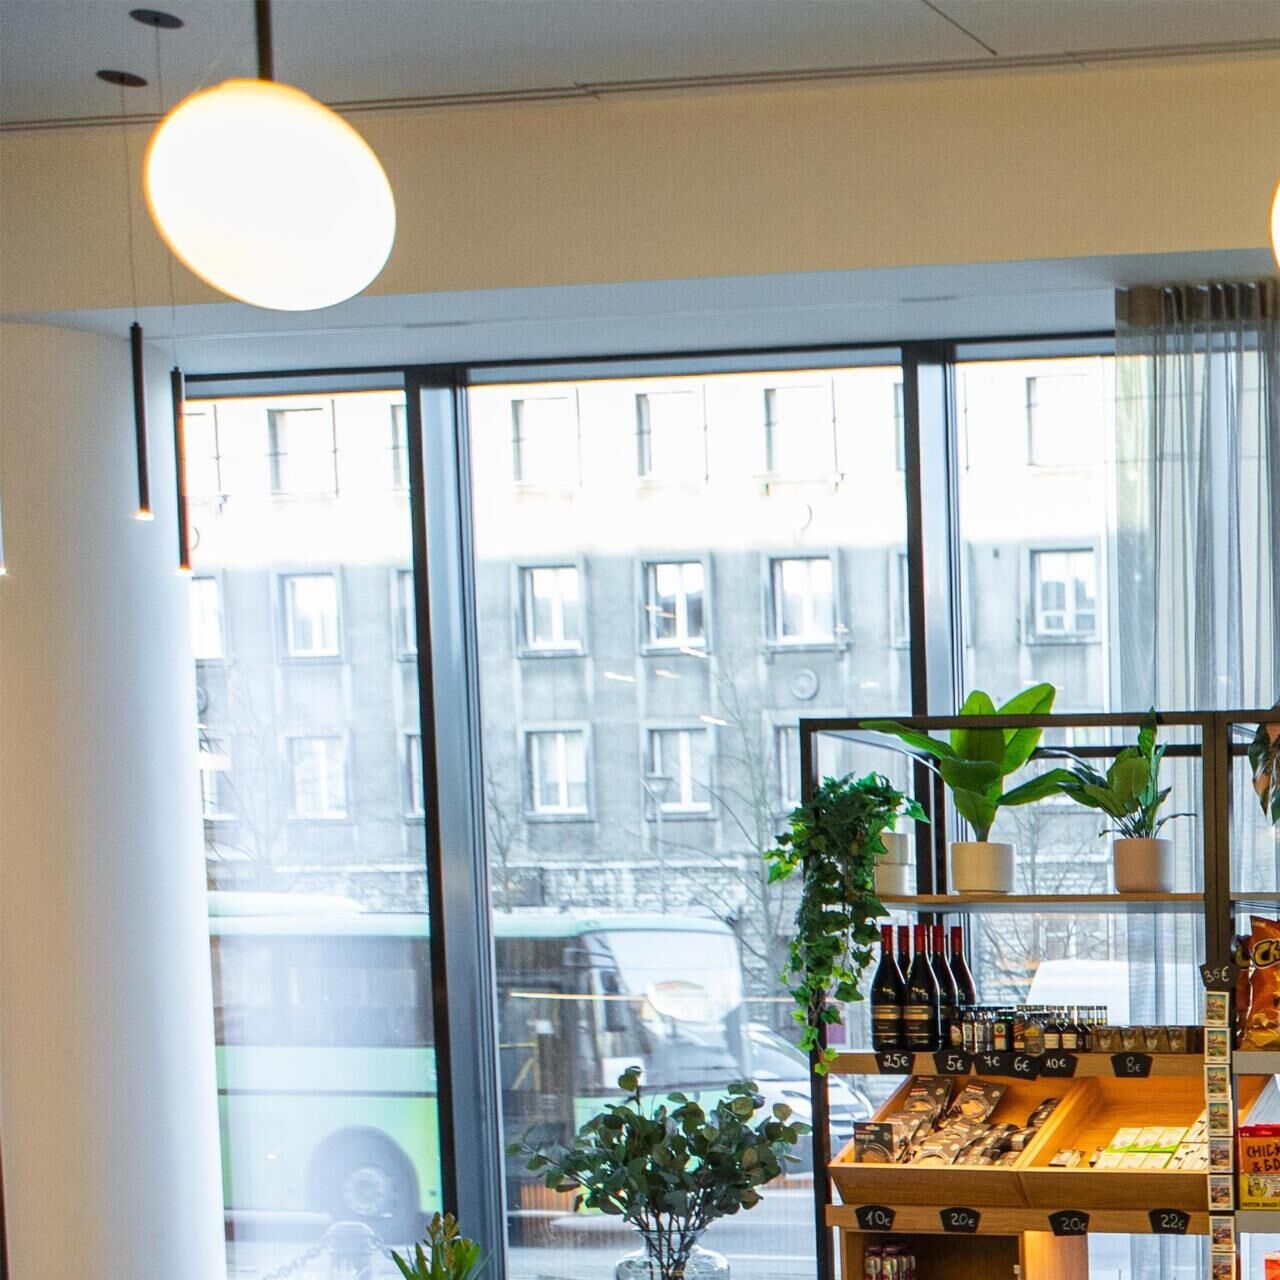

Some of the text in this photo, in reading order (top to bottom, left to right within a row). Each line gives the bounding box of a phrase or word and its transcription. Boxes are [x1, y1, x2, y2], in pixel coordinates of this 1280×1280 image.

[883, 1053, 909, 1069] 25€
[946, 1055, 964, 1071] 5€
[1014, 1057, 1030, 1072] 6€
[1045, 1057, 1067, 1069] 10€
[1126, 1056, 1141, 1073] 8€
[865, 1211, 891, 1226] 10€
[951, 1213, 976, 1227] 20€
[1061, 1217, 1087, 1232] 20€
[1160, 1214, 1185, 1230] 22€
